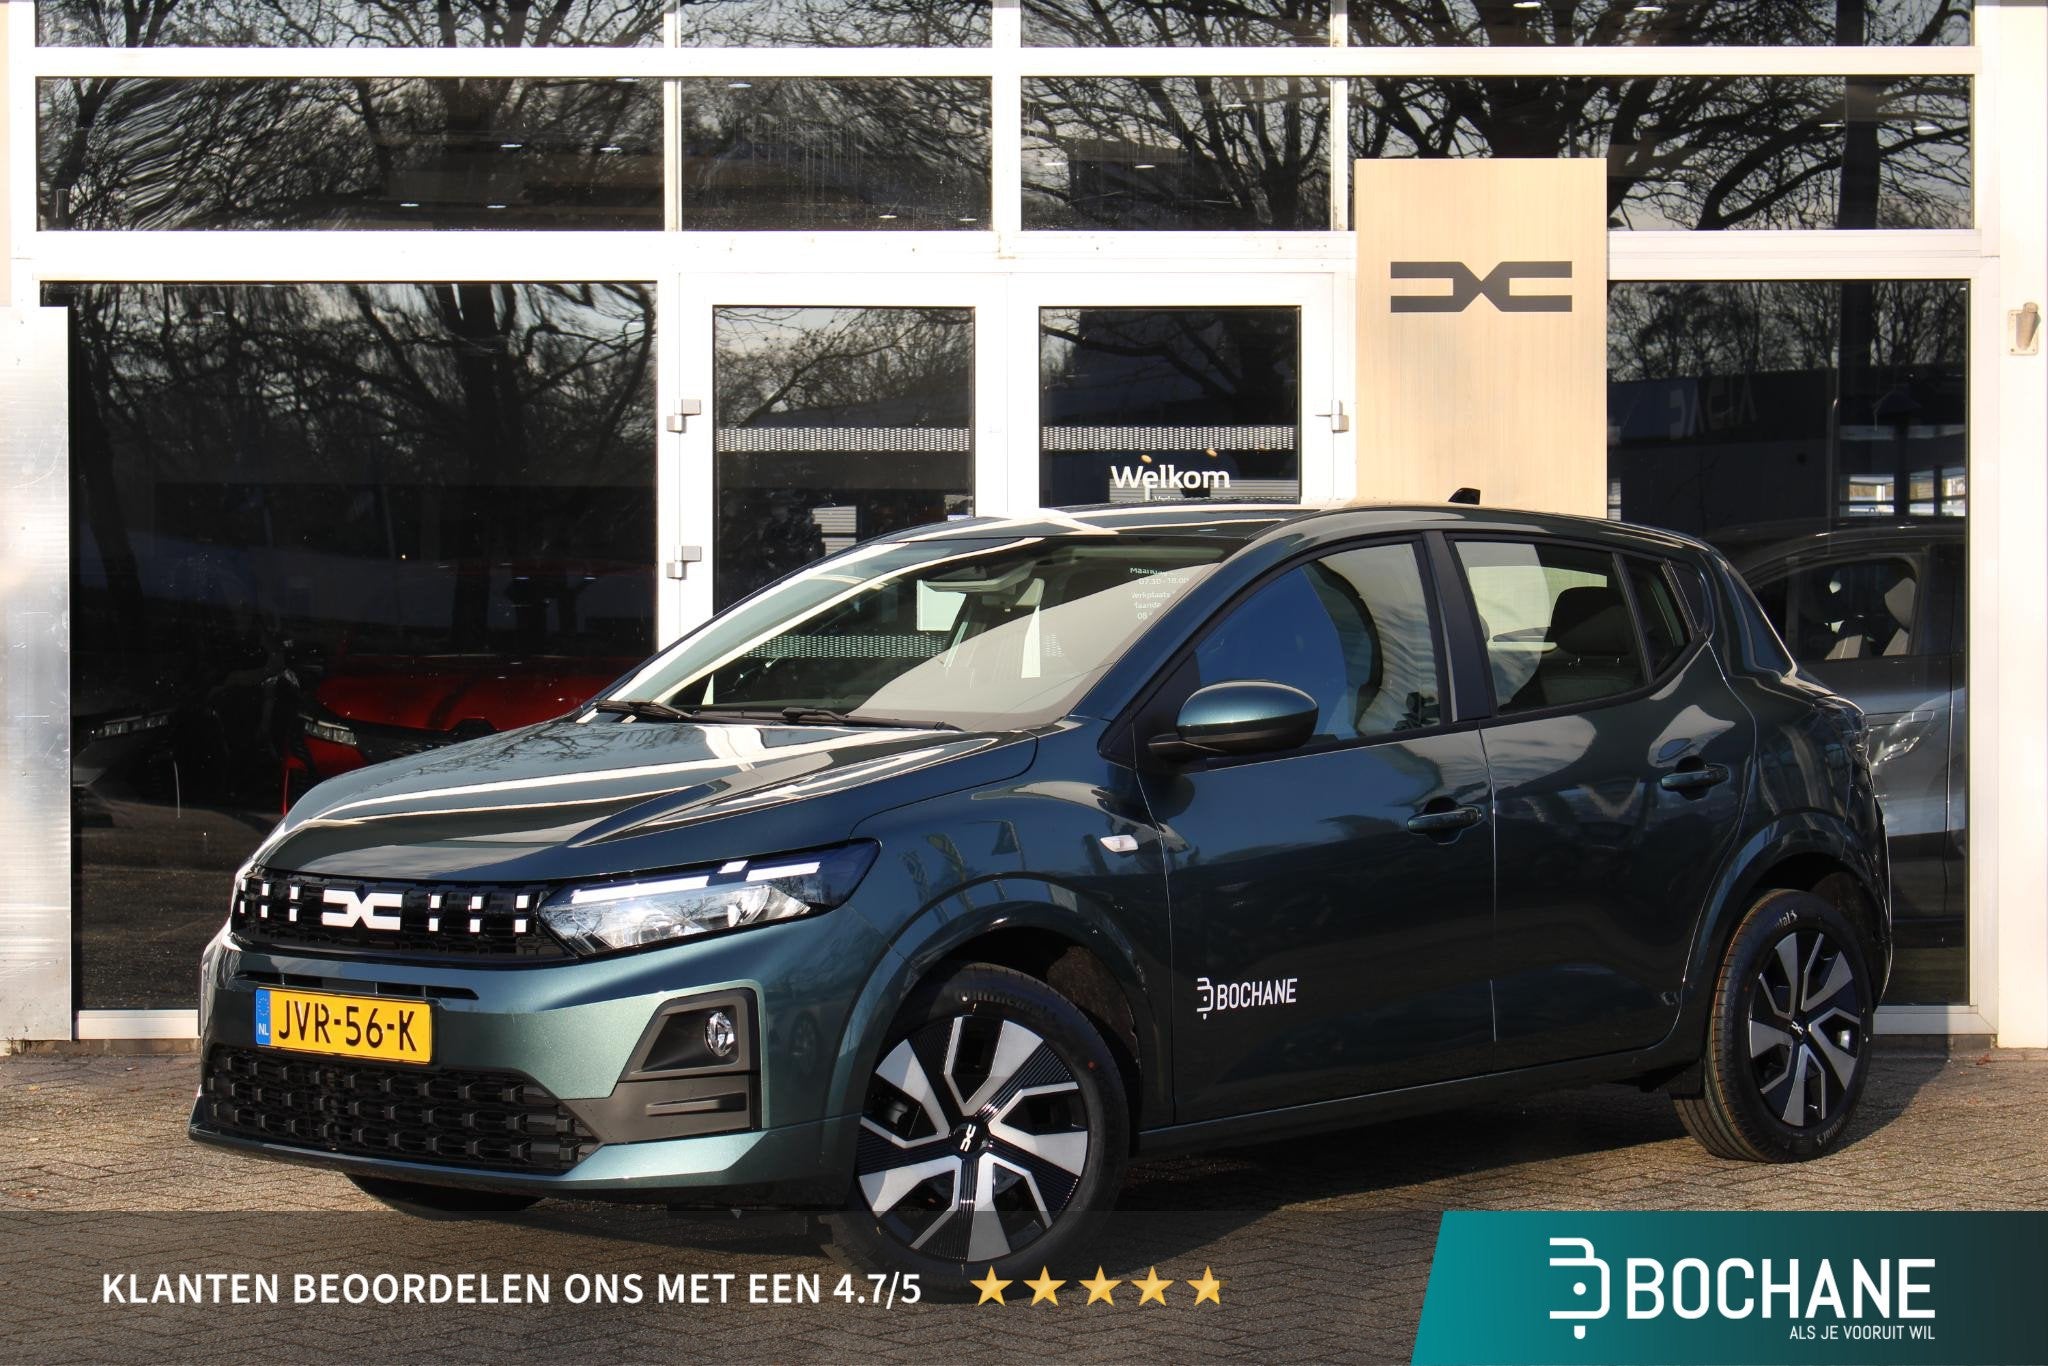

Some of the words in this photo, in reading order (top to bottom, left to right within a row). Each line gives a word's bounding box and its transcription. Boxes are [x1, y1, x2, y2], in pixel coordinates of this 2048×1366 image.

[1110, 464, 1231, 489] Welkom
[1216, 977, 1298, 1011] BOCHANE
[258, 1022, 269, 1036] NL
[278, 999, 417, 1052] JVR-56-K
